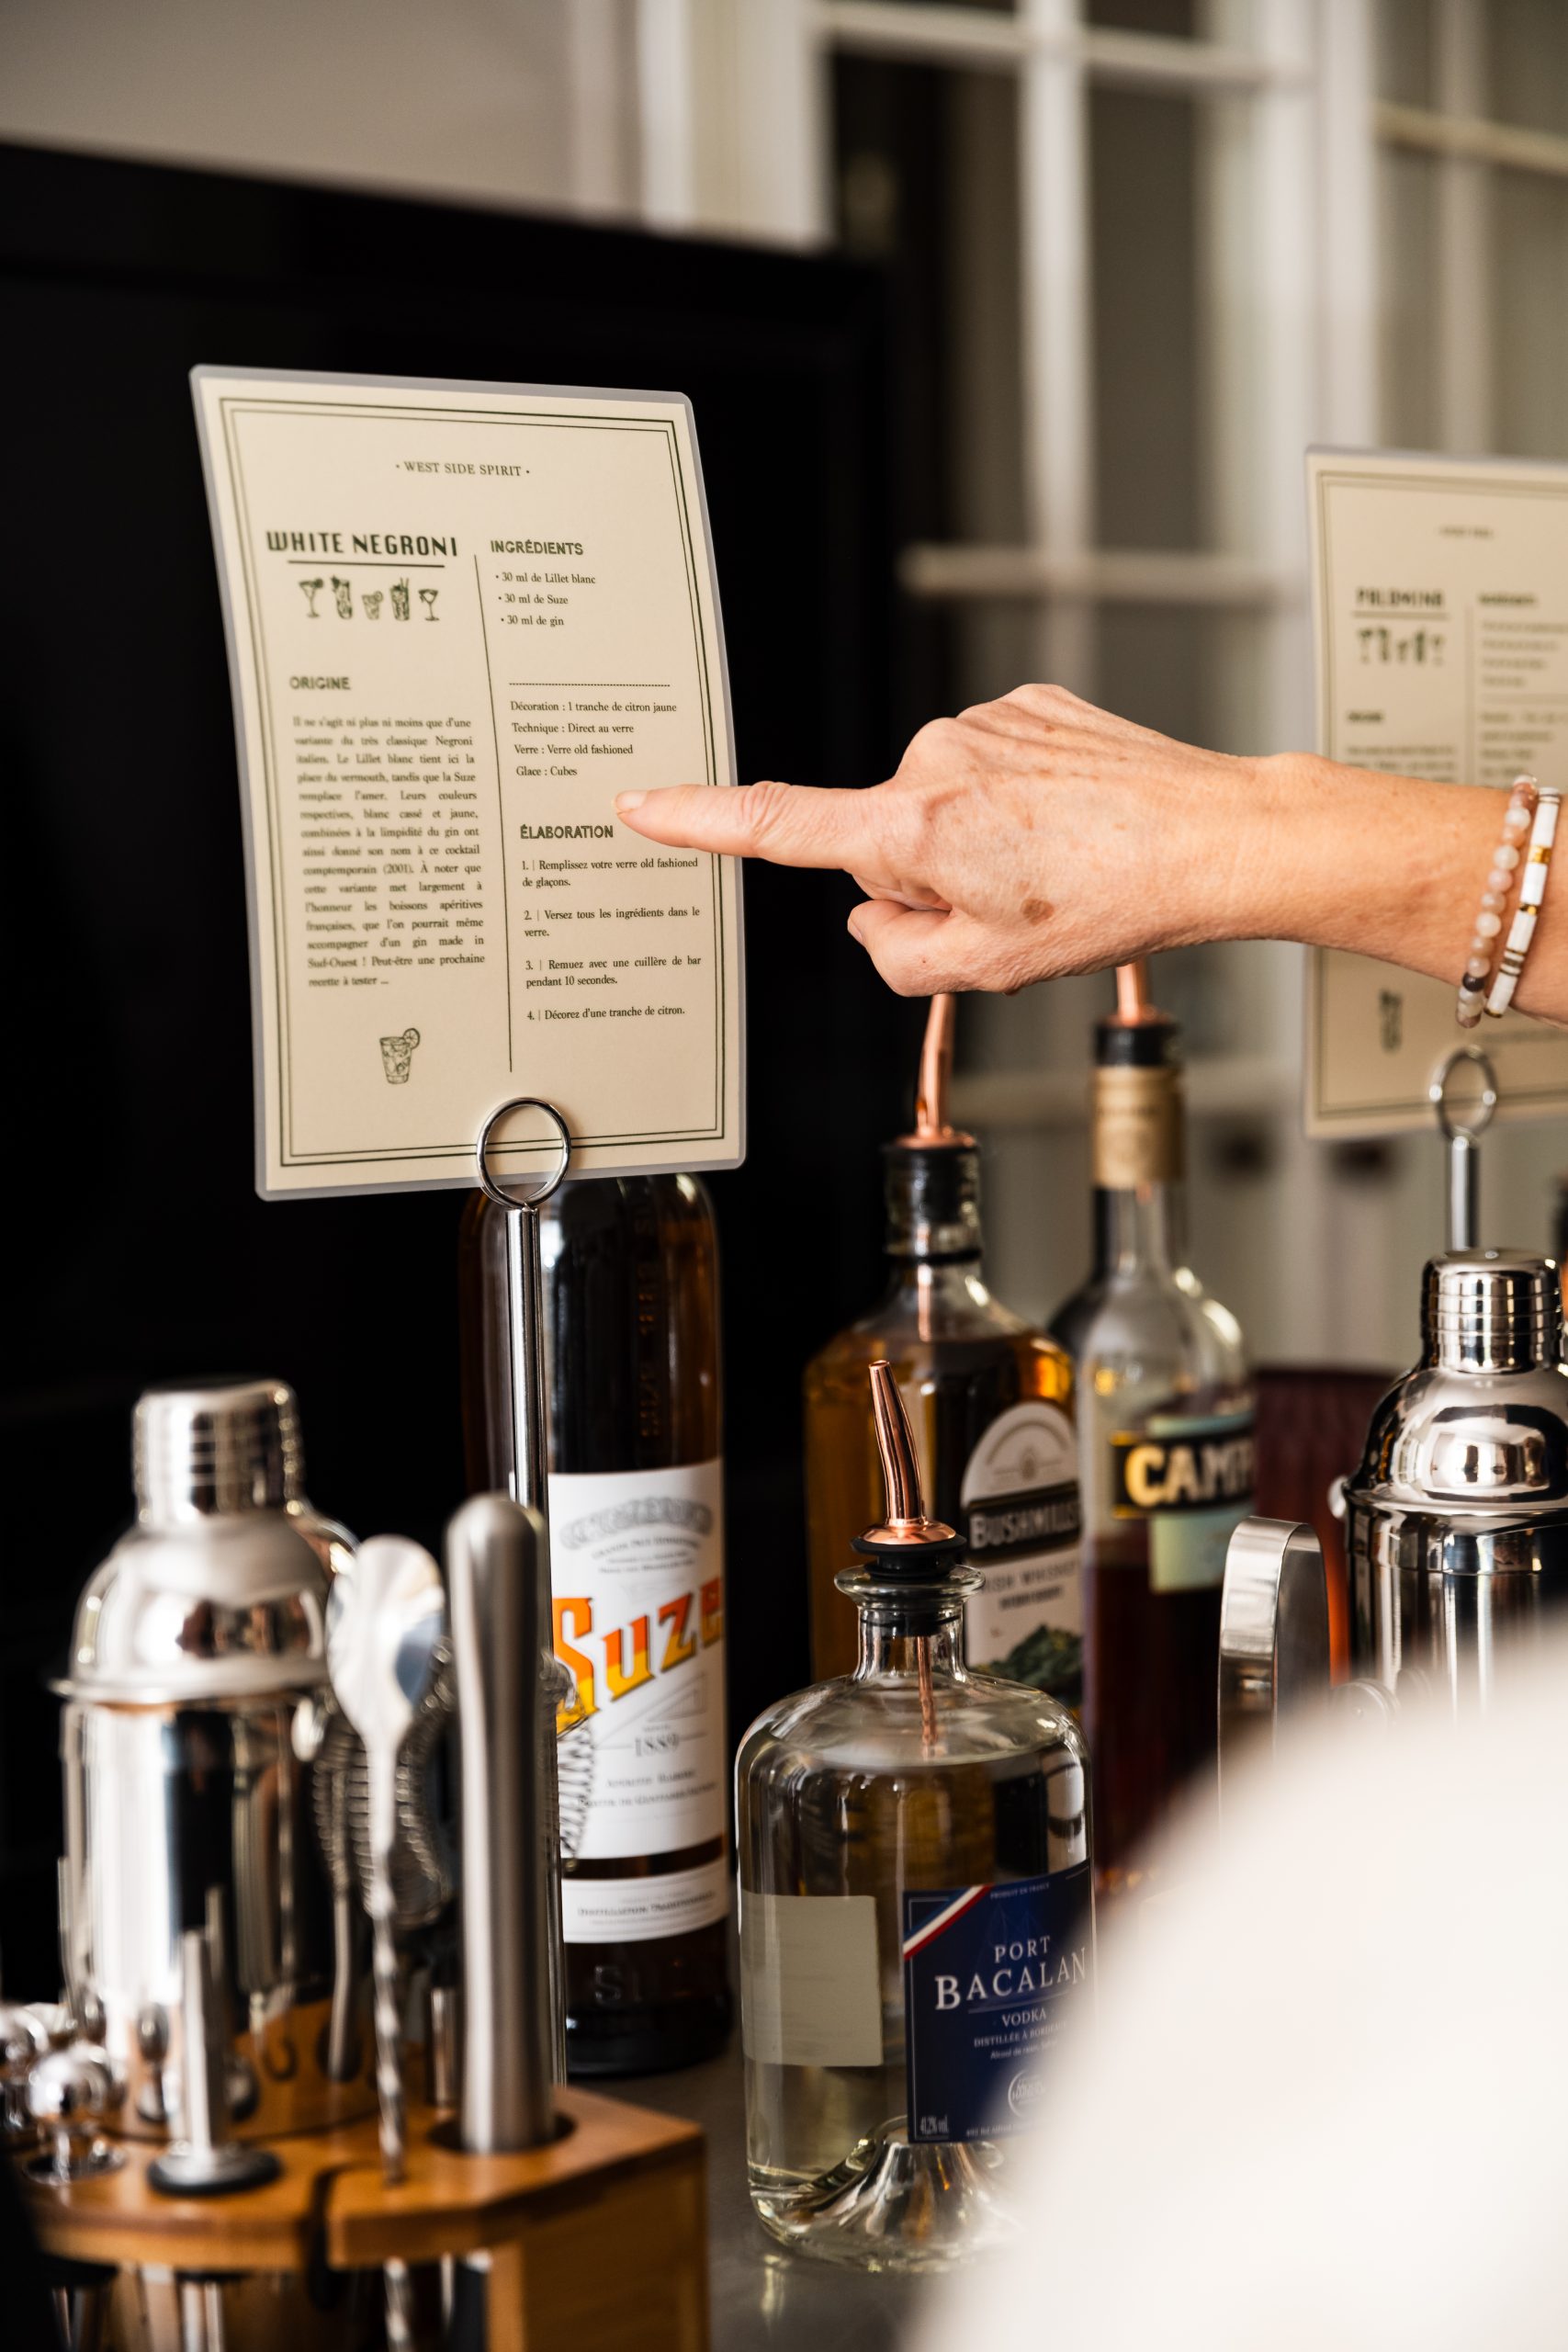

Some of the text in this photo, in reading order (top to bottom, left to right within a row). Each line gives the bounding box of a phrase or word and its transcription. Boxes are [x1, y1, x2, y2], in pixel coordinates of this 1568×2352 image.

[403, 461, 521, 476] WEST SIDE SPIRIT
[265, 531, 457, 556] WHITE NEGRONI
[489, 538, 584, 555] INGRÉDIENTS
[502, 571, 595, 583] 30 ml de Lillet blanc
[504, 593, 568, 604] 30 ml de Suze
[507, 614, 564, 627] 30 ml de gin
[288, 675, 352, 690] ORIGINE
[510, 700, 676, 713] Décoration 1 tranche de citron jaune
[358, 716, 378, 729] plus
[381, 717, 391, 727] ni
[394, 718, 423, 728] moins
[425, 719, 443, 729] que
[445, 717, 470, 728] d'une
[511, 722, 558, 734] Technique
[568, 722, 595, 732] Direct
[360, 735, 472, 748] très classique Negroni
[513, 743, 633, 753] Verre Verre old fashioned
[387, 753, 412, 763] blanc
[419, 753, 441, 763] tient
[447, 754, 459, 763] ici
[466, 752, 475, 763] la
[515, 765, 577, 775] Glace Cubes
[391, 772, 420, 782] tandis
[422, 775, 439, 784] que
[442, 771, 451, 782] la
[454, 771, 476, 781] Suze
[400, 789, 426, 800] Leurs
[437, 789, 477, 799] couleurs
[363, 808, 478, 820] blanc cassé et jaune,
[366, 827, 375, 837] la
[379, 826, 423, 839] limpidité
[426, 826, 439, 836] du
[444, 826, 459, 838] gin
[463, 828, 479, 836] ont
[519, 823, 615, 839] ÉLABORATION
[389, 847, 411, 855] nom
[417, 845, 423, 854] à
[445, 843, 479, 854] cocktail
[420, 860, 428, 873] À
[434, 865, 458, 873] noter
[463, 865, 481, 875] que
[522, 860, 529, 870] 1.
[538, 859, 588, 871] Remplissez
[590, 860, 613, 868] votre
[639, 857, 654, 867] old
[657, 856, 698, 867] fashioned
[389, 883, 407, 892] met
[418, 881, 465, 893] largement
[476, 880, 482, 889] à
[522, 876, 570, 888] de glaçons.
[364, 900, 378, 911] les
[389, 900, 428, 910] boissons
[439, 899, 483, 911] apéritives
[524, 906, 700, 920] 2. Versez tous les ingrédients dans le
[362, 917, 483, 932] que l'on pourrait même
[379, 934, 484, 948] d'un gin made in
[371, 953, 485, 967] Peut-être une prochaine
[525, 959, 533, 970] 3.
[547, 959, 583, 969] Remuez
[634, 956, 667, 967] cuillère
[671, 955, 682, 965] de
[686, 955, 701, 965] bar
[525, 974, 617, 989] pendant 10 secondes.
[526, 1005, 684, 1020] 4. Décorez d'une tranche de citron.
[969, 1499, 1078, 1550] BUSHMILLS
[552, 1577, 724, 1736] Suze
[994, 1935, 1051, 1964] PORT
[934, 1947, 1087, 2010] BACALAN
[1001, 2007, 1048, 2029] VODKA
[974, 2031, 1021, 2049] DISTILLÉE
